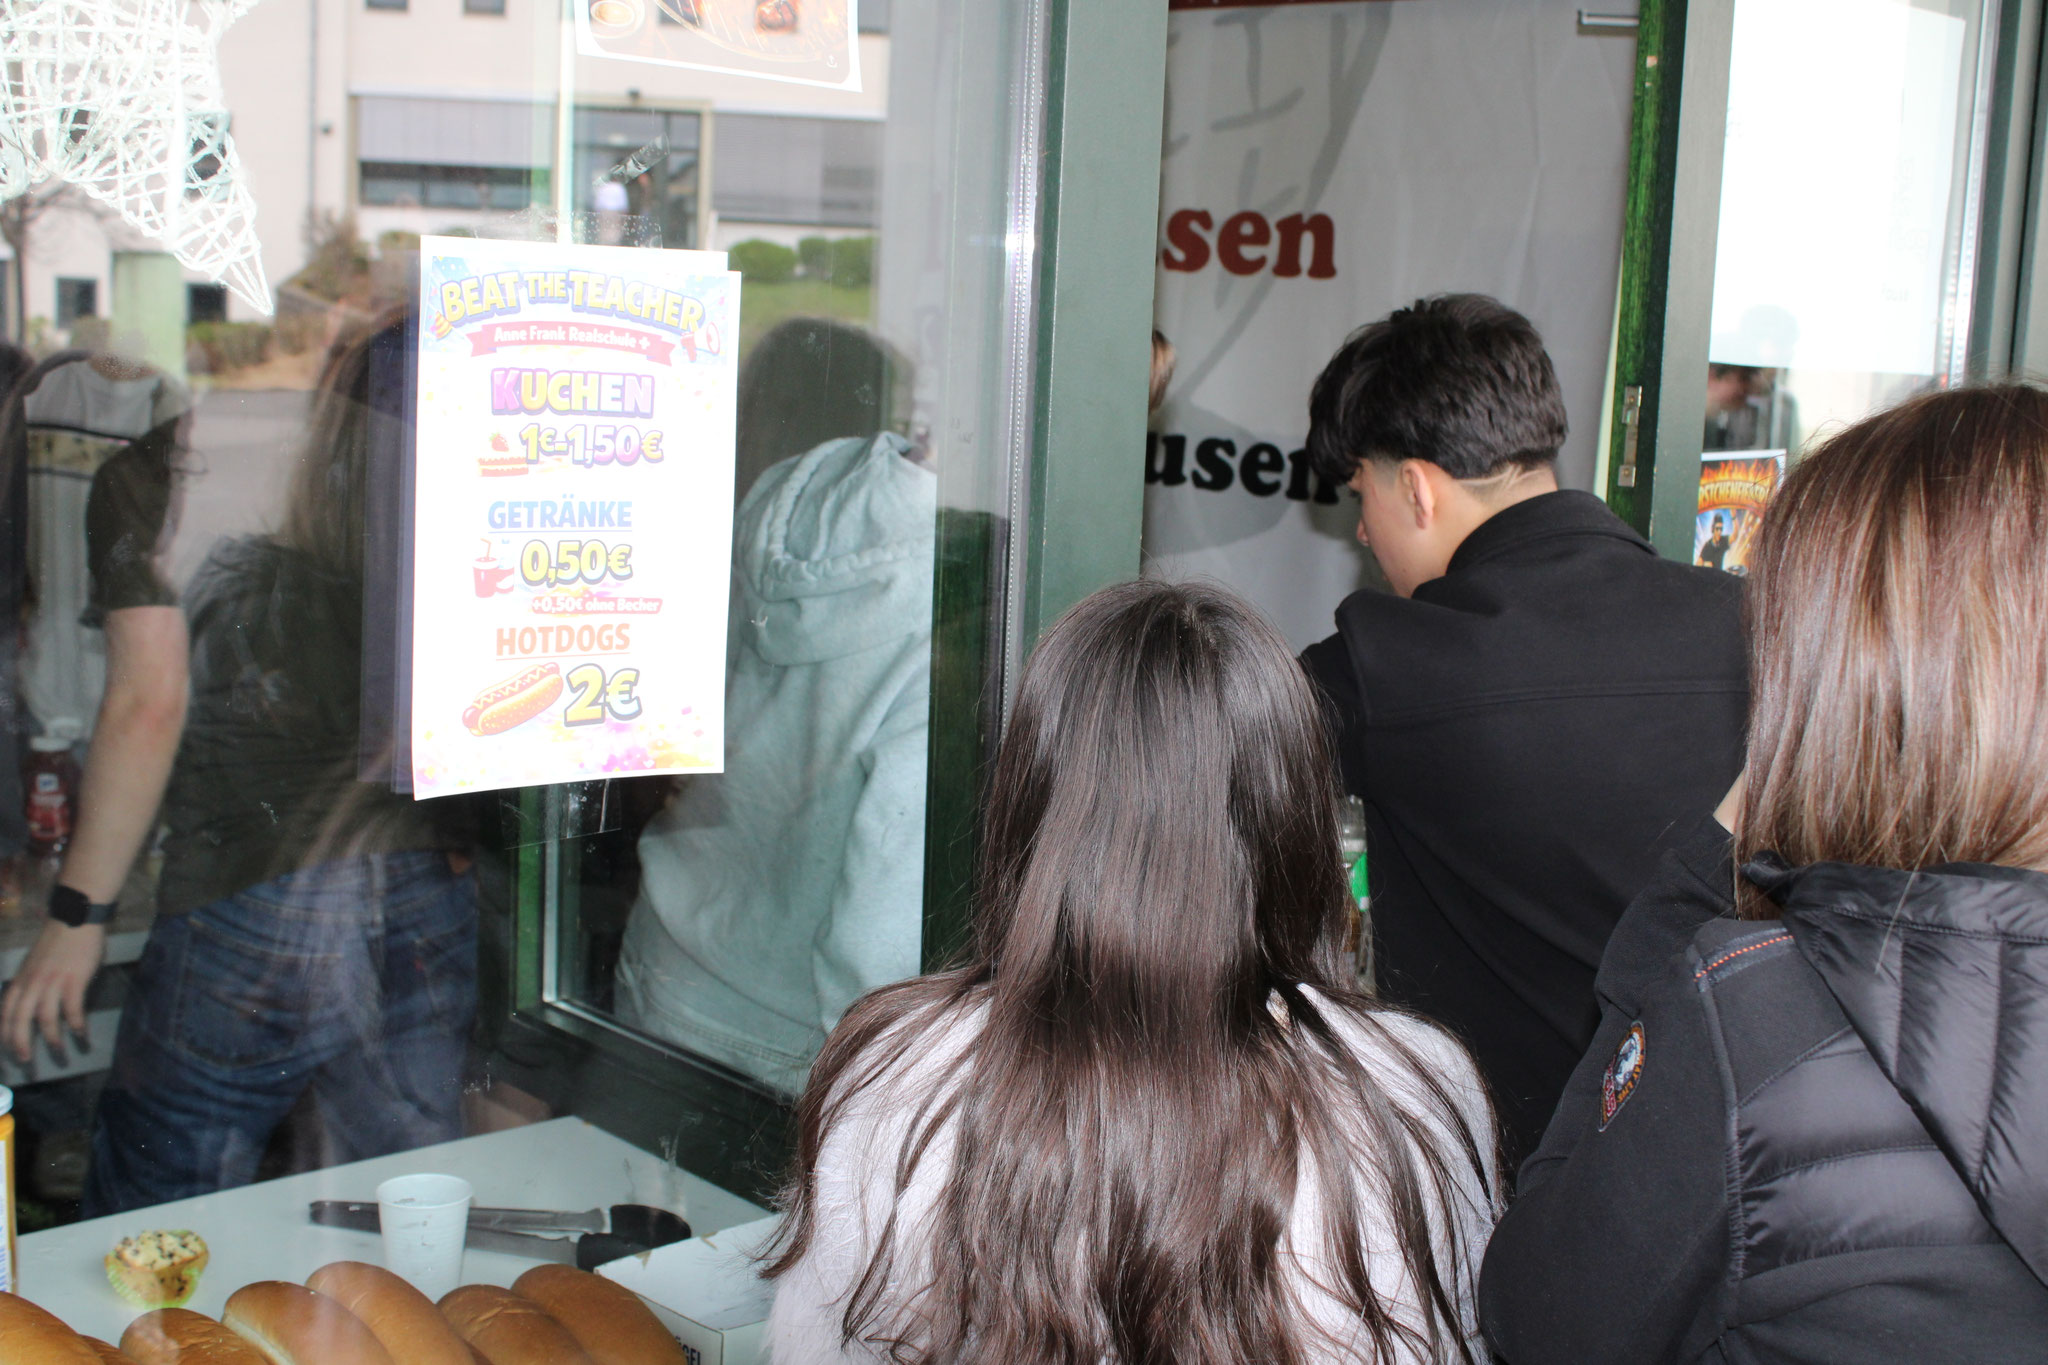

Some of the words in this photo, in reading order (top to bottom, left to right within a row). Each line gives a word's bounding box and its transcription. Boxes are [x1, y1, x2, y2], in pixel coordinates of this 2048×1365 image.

[441, 270, 521, 327] BEAT
[524, 271, 571, 304] THE
[567, 270, 705, 335] TEACHER
[494, 326, 527, 342] Anne
[529, 325, 566, 341] Frank
[568, 326, 637, 348] Realschule
[491, 368, 655, 418] KUCHEN
[488, 493, 632, 530] GETRÄNKE
[520, 539, 633, 588] 0,50€
[585, 598, 615, 611] ohne
[617, 597, 660, 612] Becher
[496, 624, 630, 656] HOTDOGS
[564, 663, 642, 727] 2€
